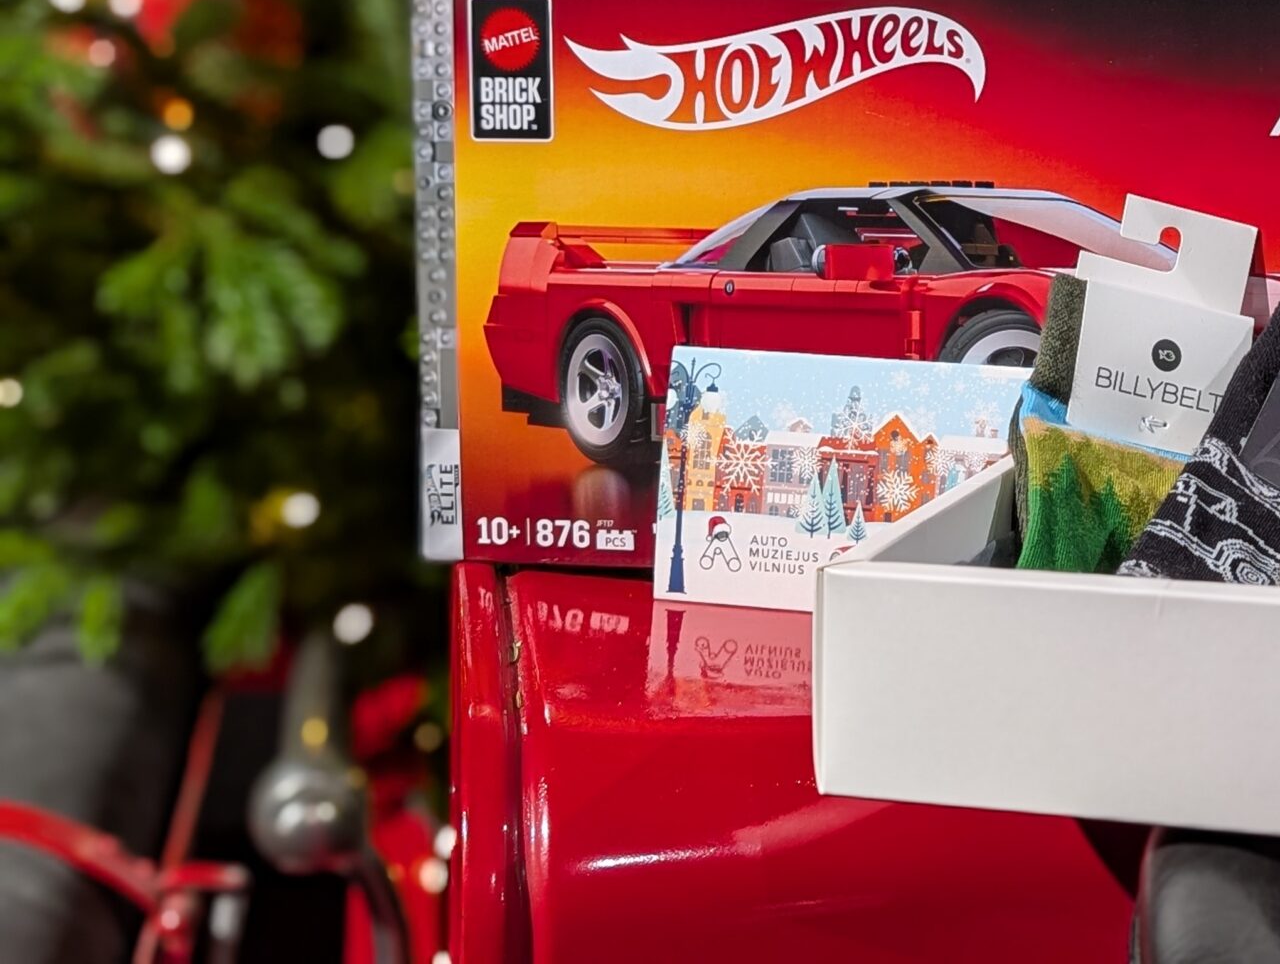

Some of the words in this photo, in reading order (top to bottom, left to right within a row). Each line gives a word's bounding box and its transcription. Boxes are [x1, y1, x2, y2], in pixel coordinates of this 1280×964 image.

[483, 26, 540, 54] MATTEL
[480, 77, 542, 104] BRICK
[658, 42, 782, 125] HOT
[1095, 366, 1225, 414] BILLYBELT
[439, 464, 455, 526] ELITE
[477, 516, 521, 545] 10+
[536, 518, 591, 548] 876
[605, 537, 626, 548] PCS
[750, 535, 788, 548] AUTO
[749, 547, 819, 563] MUZIEJUS
[749, 561, 805, 575] VILNIUS
